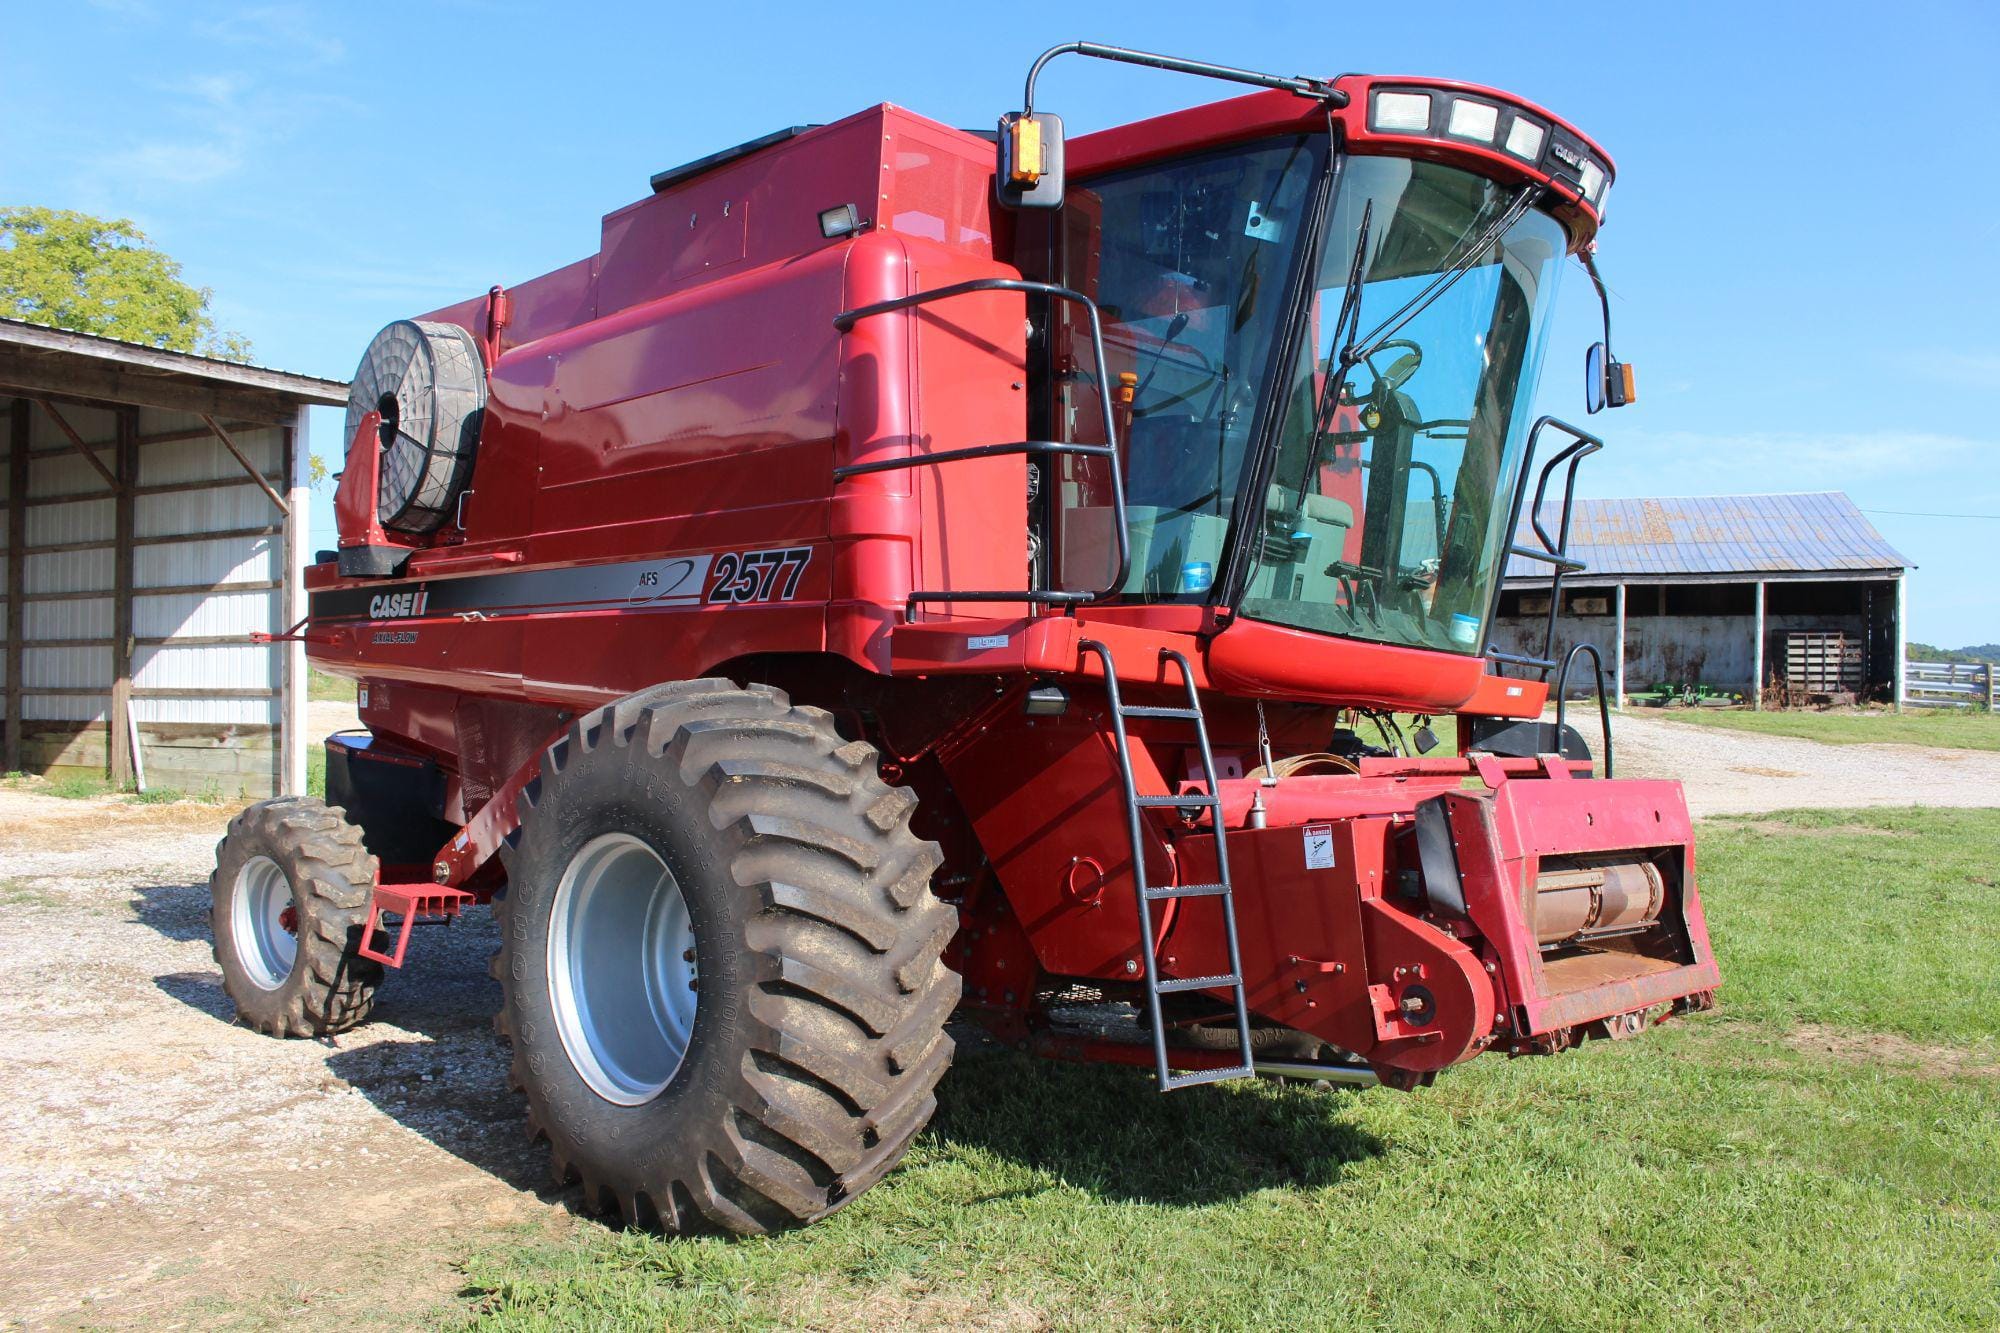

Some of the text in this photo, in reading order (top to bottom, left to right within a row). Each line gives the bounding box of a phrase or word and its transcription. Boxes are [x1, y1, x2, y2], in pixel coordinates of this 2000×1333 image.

[639, 571, 658, 586] AFS
[707, 545, 814, 604] 2577
[372, 631, 419, 644] AXIAL-FLOW
[711, 884, 738, 1045] TRACTION
